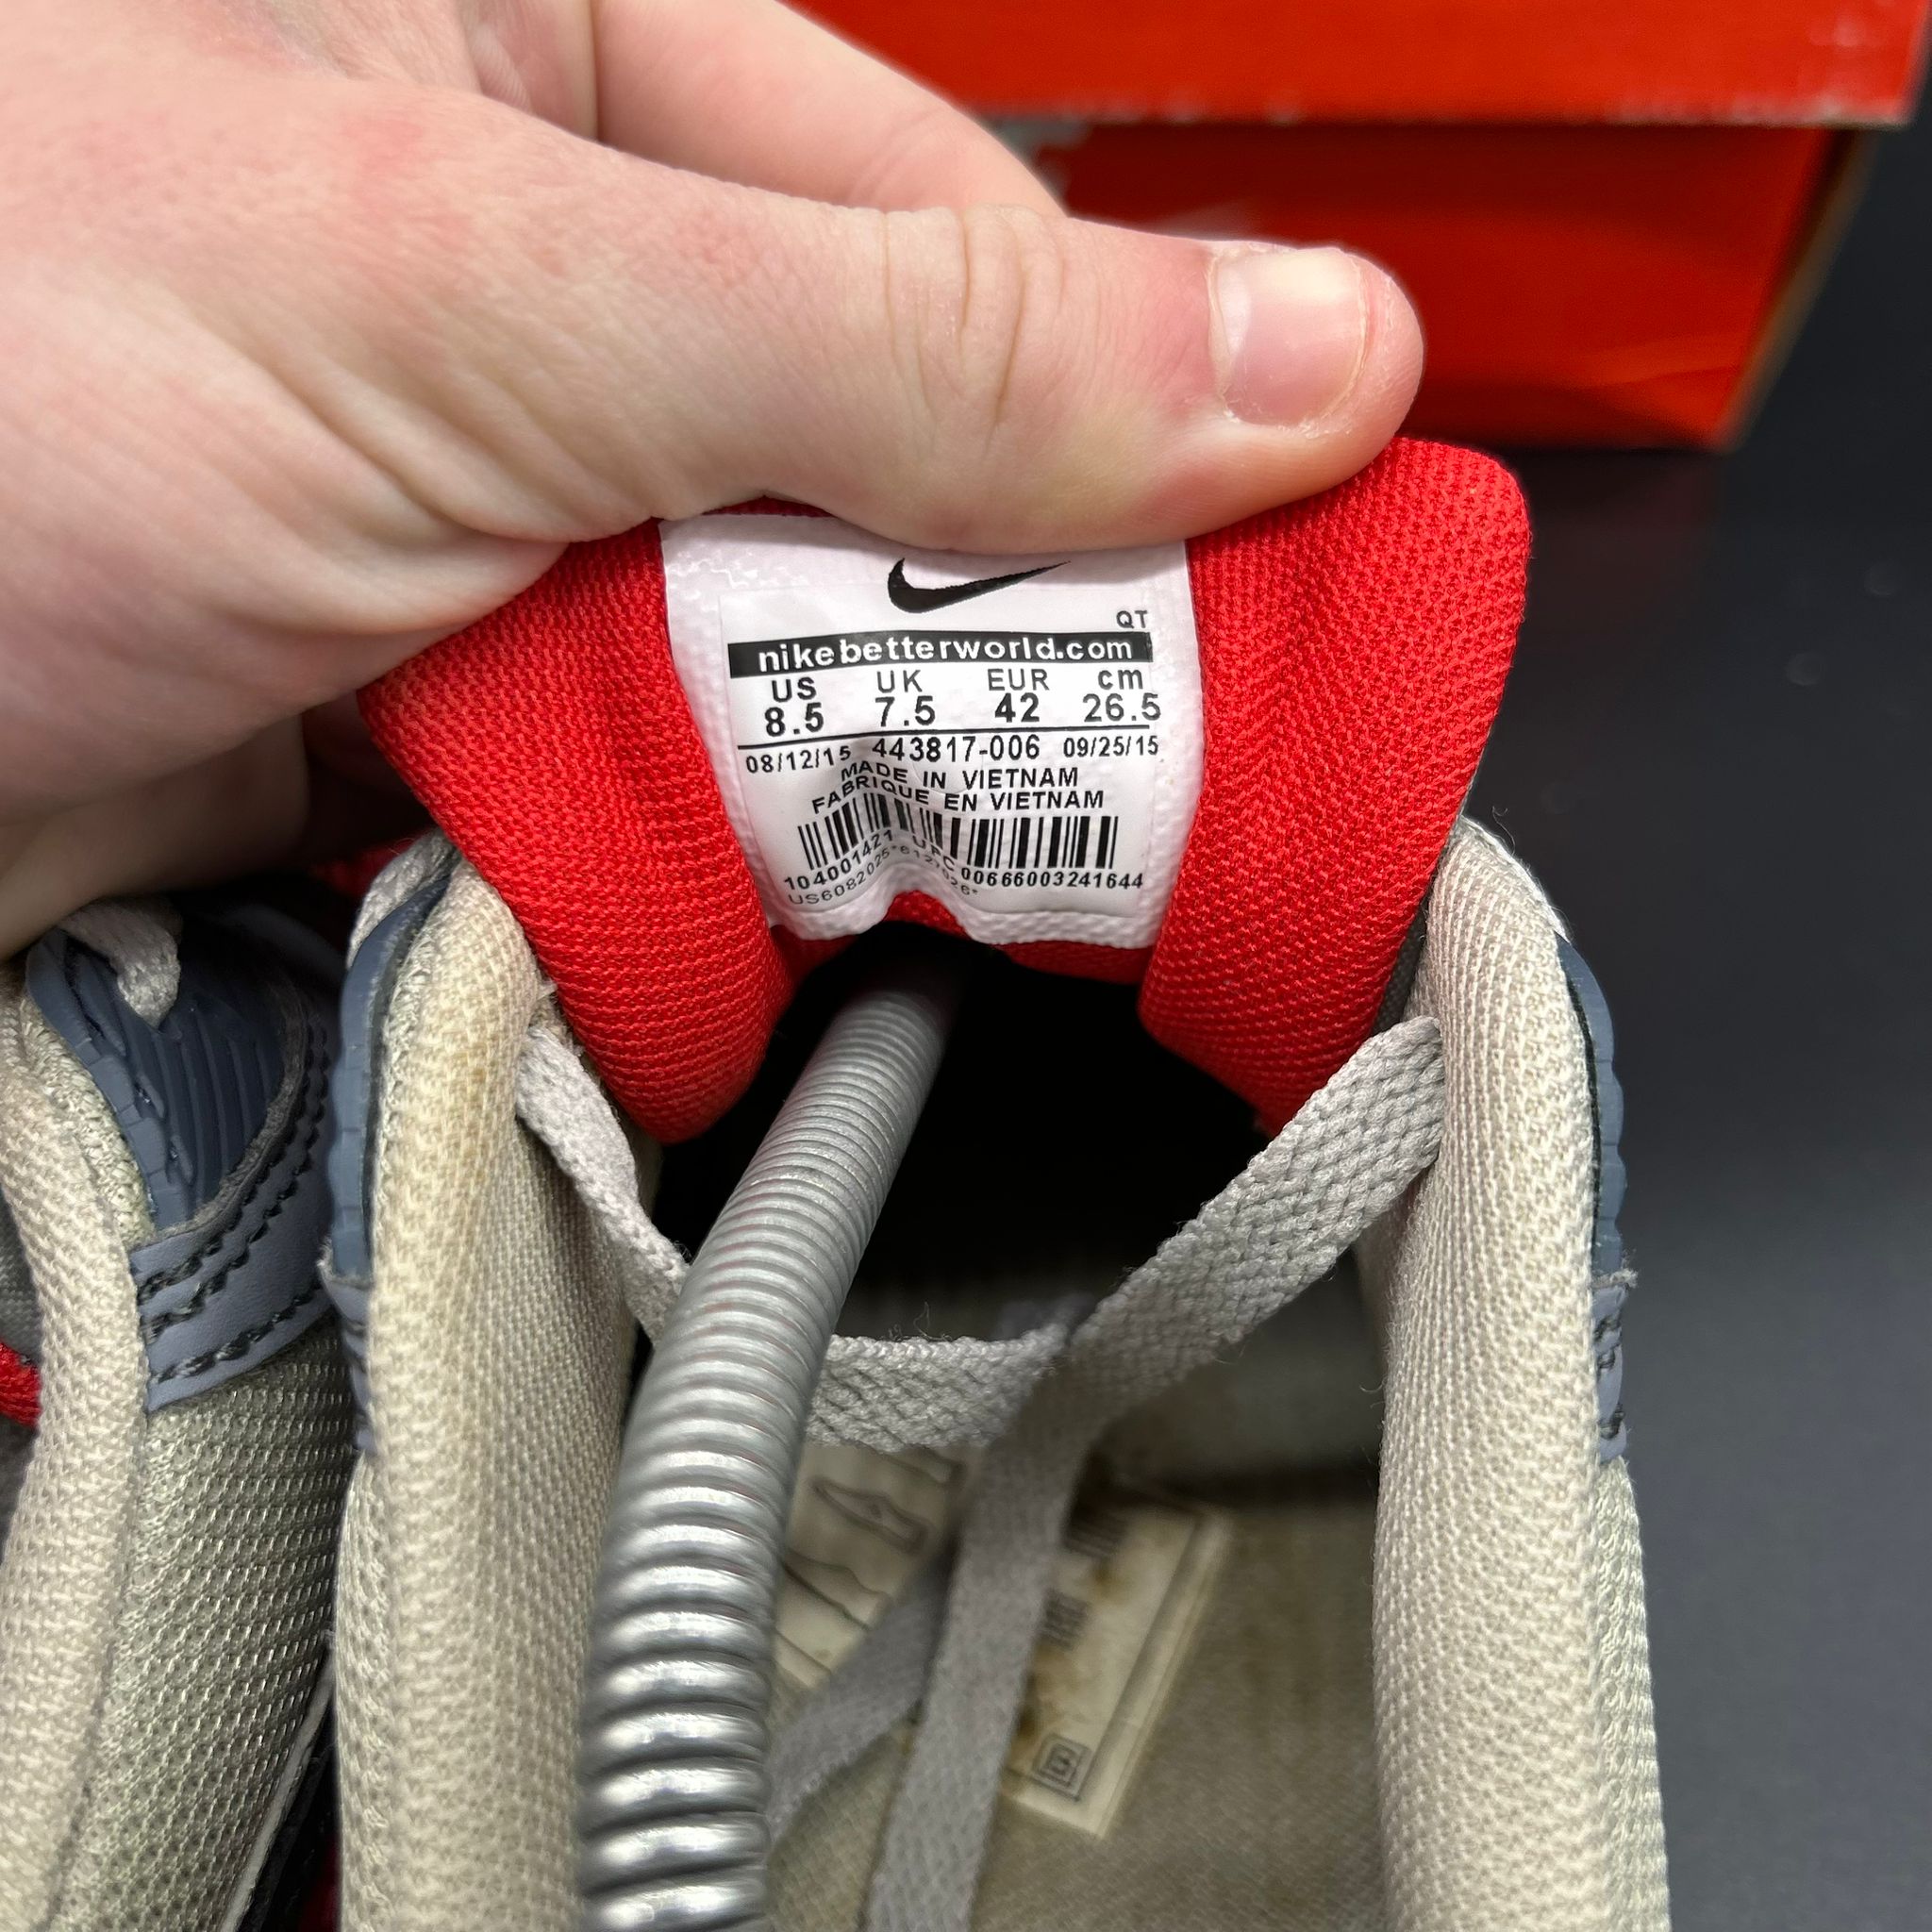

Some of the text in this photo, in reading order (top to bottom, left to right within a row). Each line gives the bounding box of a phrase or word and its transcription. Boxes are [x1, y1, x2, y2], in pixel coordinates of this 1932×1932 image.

[1116, 609, 1148, 628] QT
[771, 668, 1143, 703] US UK EUR cm
[764, 692, 1161, 737] 8.5 7.5 42 26.5
[745, 734, 1158, 774] 08/12/15 443817-006 09/25/15
[812, 775, 1104, 814] FABRIQUE EN VIETNAM
[841, 760, 1078, 790] MADE IN VIETNAM
[784, 829, 893, 891] 104001421
[960, 867, 1143, 890] 00666003241644
